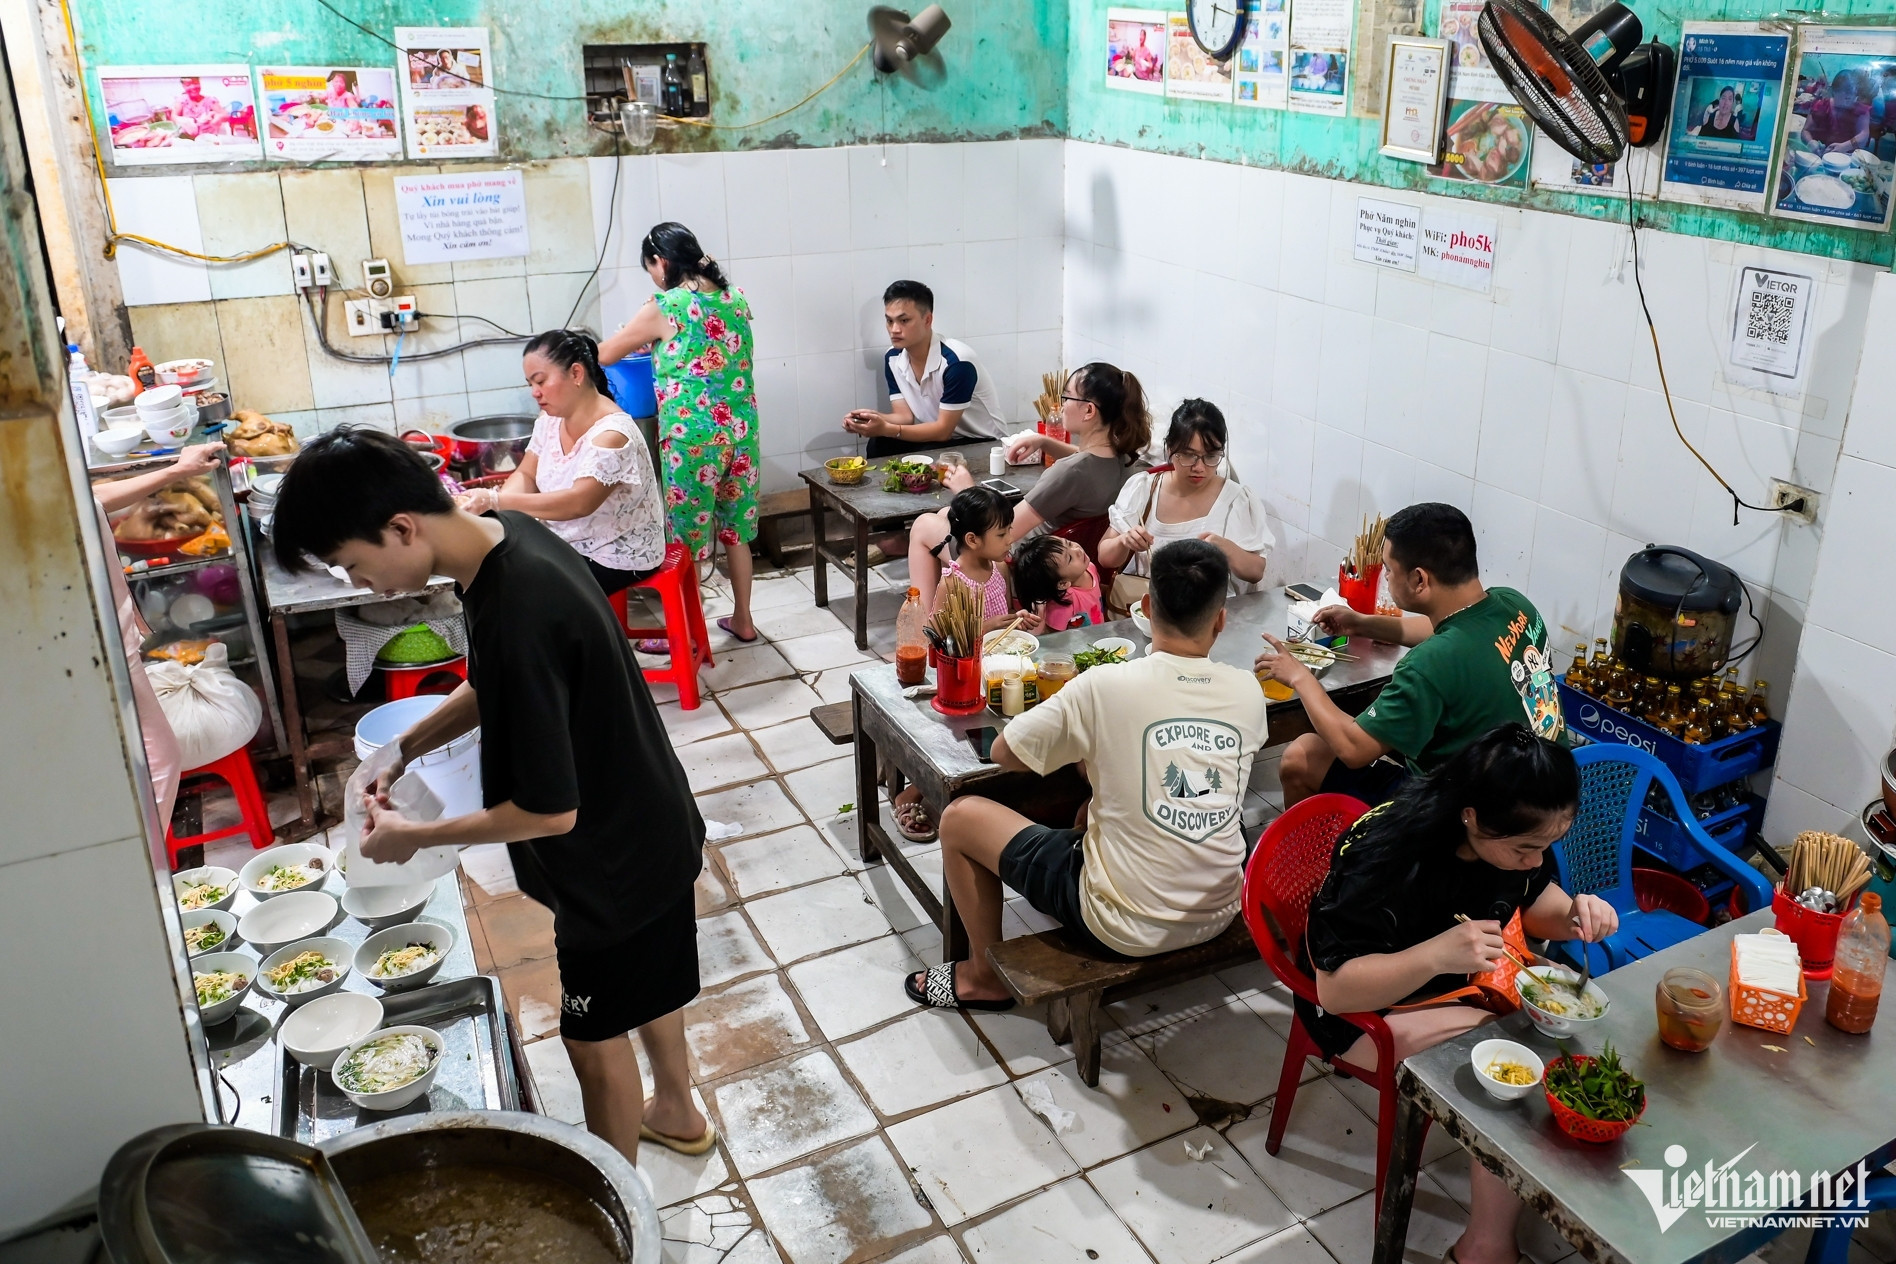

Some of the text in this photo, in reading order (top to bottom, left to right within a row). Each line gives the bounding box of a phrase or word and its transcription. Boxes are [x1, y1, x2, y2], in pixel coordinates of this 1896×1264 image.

[1762, 60, 1777, 68] không
[420, 182, 445, 192] khách
[484, 180, 506, 188] mang
[422, 192, 501, 208] Xin vui lòng
[1360, 209, 1416, 229] Phở Năm nghìn
[407, 234, 432, 243] Mong
[433, 232, 451, 241] Quý
[454, 229, 478, 238] khách
[480, 228, 502, 238] thông
[1360, 222, 1414, 241] Phục vụ Quý khách:
[1424, 229, 1492, 253] WiFi: pho5k
[442, 242, 457, 250] Xin
[1422, 246, 1439, 258] MK:
[1440, 251, 1490, 270] phonamnghin
[1754, 272, 1798, 294] VIETQR
[1155, 725, 1236, 750] EXPLORE GO
[1191, 742, 1212, 752] AND
[1600, 719, 1657, 756] pepsi
[1156, 804, 1232, 831] DISCOVERY
